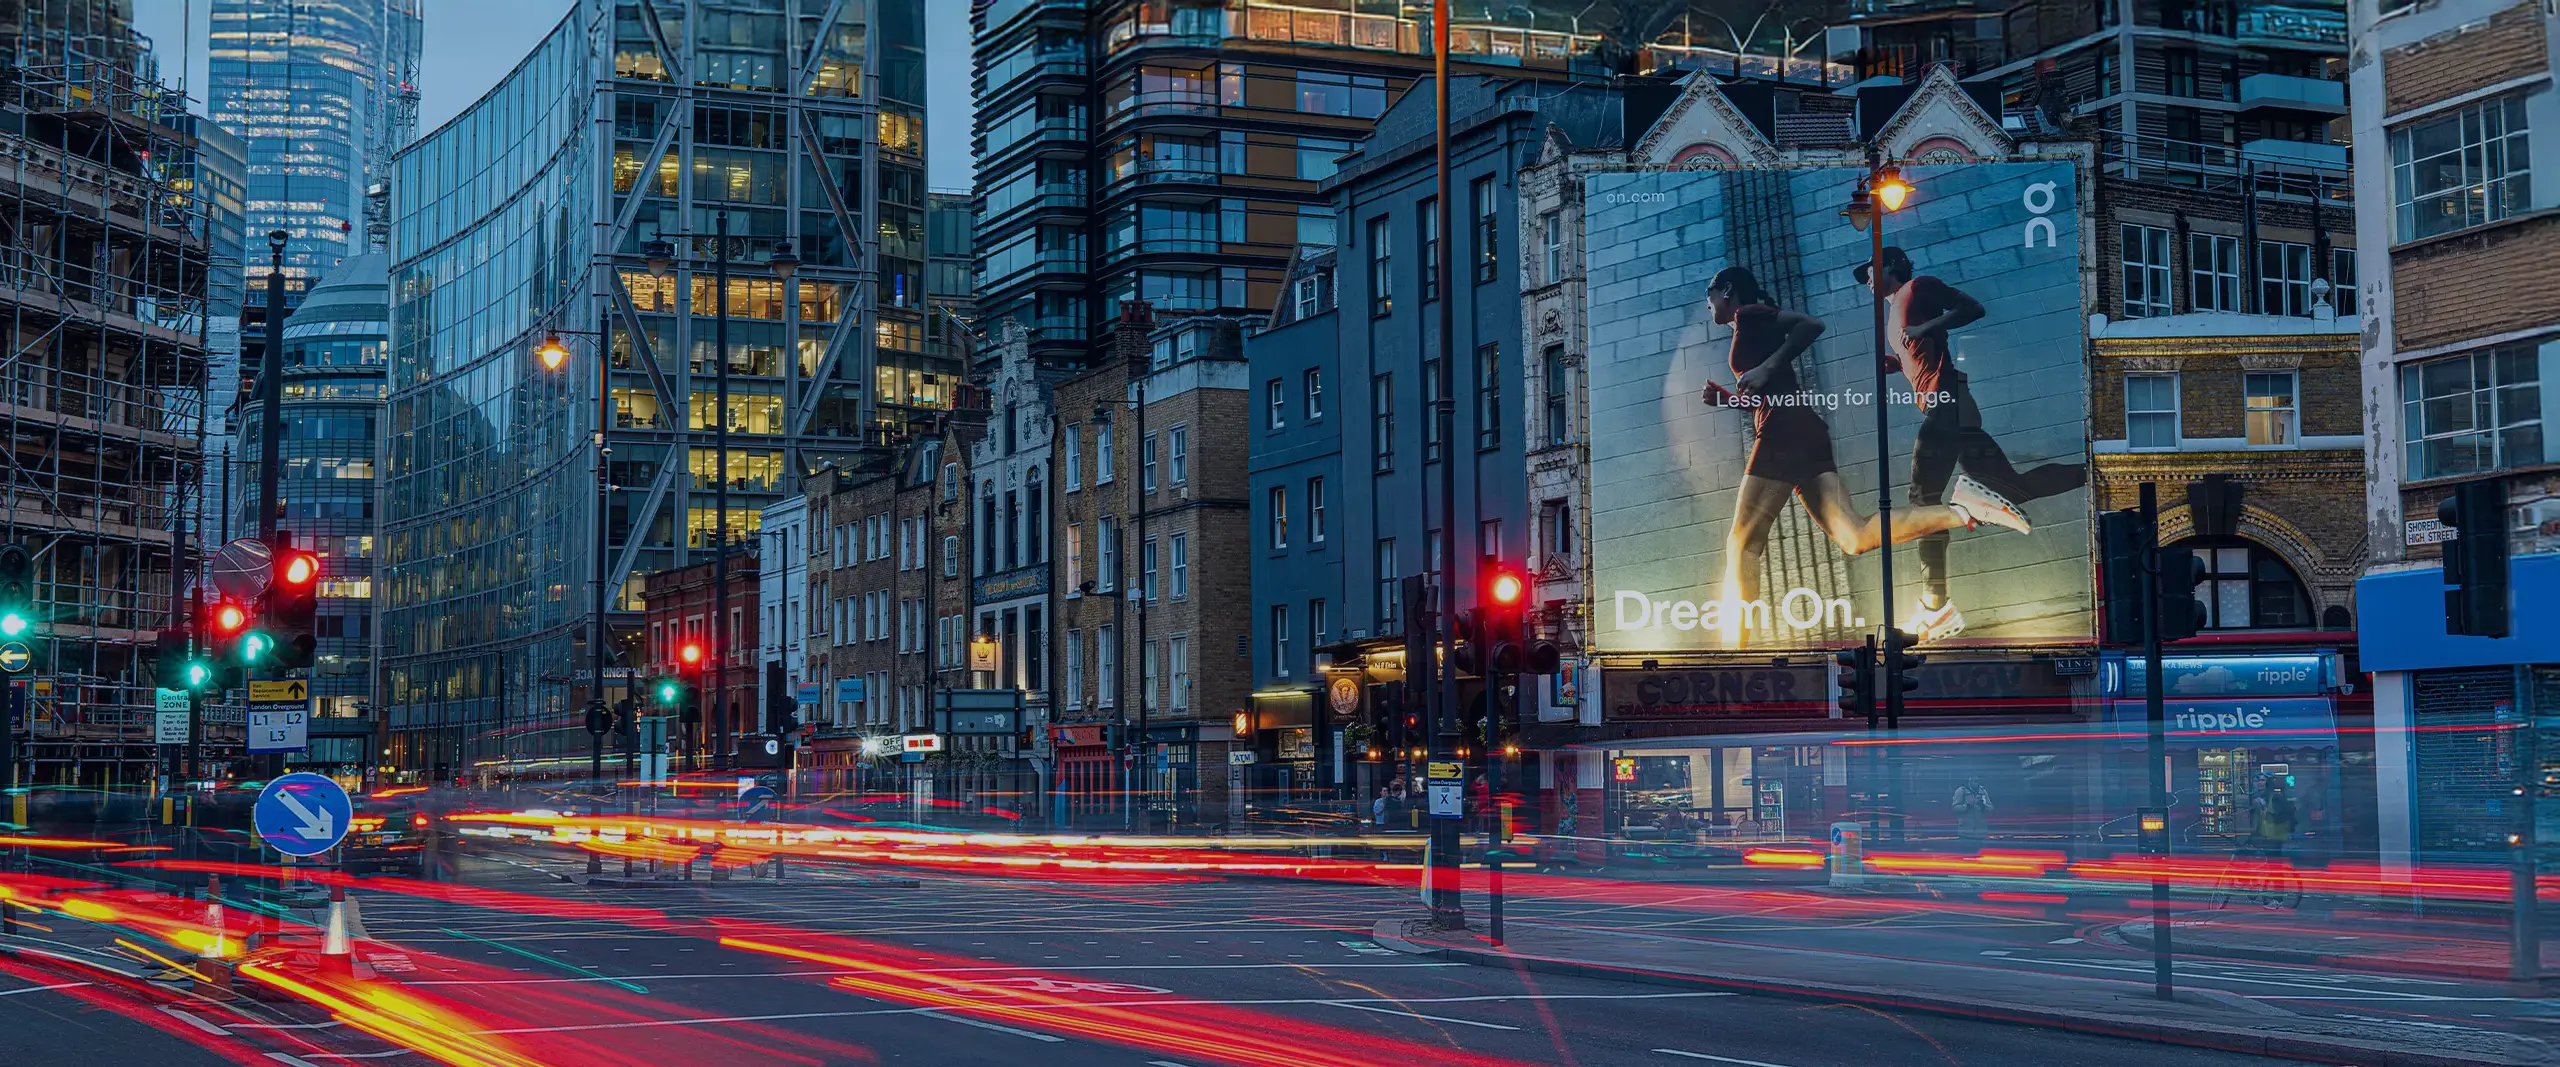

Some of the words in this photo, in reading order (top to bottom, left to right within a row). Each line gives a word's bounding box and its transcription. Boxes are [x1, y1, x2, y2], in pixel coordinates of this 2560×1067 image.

[1606, 192, 1665, 204] on.com
[1716, 390, 1762, 408] Less
[1767, 389, 1839, 411] waiting
[1843, 388, 1873, 406] for
[1884, 387, 1956, 410] hange.
[2408, 519, 2450, 532] SHOREDIT
[2408, 532, 2425, 543] HIGH
[2428, 530, 2455, 542] STREET
[1614, 589, 1770, 631] Dream
[1781, 587, 1866, 630] On.
[2057, 658, 2091, 668] KING
[1636, 671, 1796, 705] CORNER
[161, 693, 188, 701] Centra
[1559, 696, 1577, 705] OPEN
[163, 701, 188, 709] ZONE
[272, 702, 305, 710] Overground
[253, 714, 269, 726] L1
[286, 712, 302, 725] L2
[269, 730, 286, 742] L3
[882, 736, 901, 747] OFF
[1234, 753, 1251, 762] ATM
[1440, 793, 1449, 805] X
